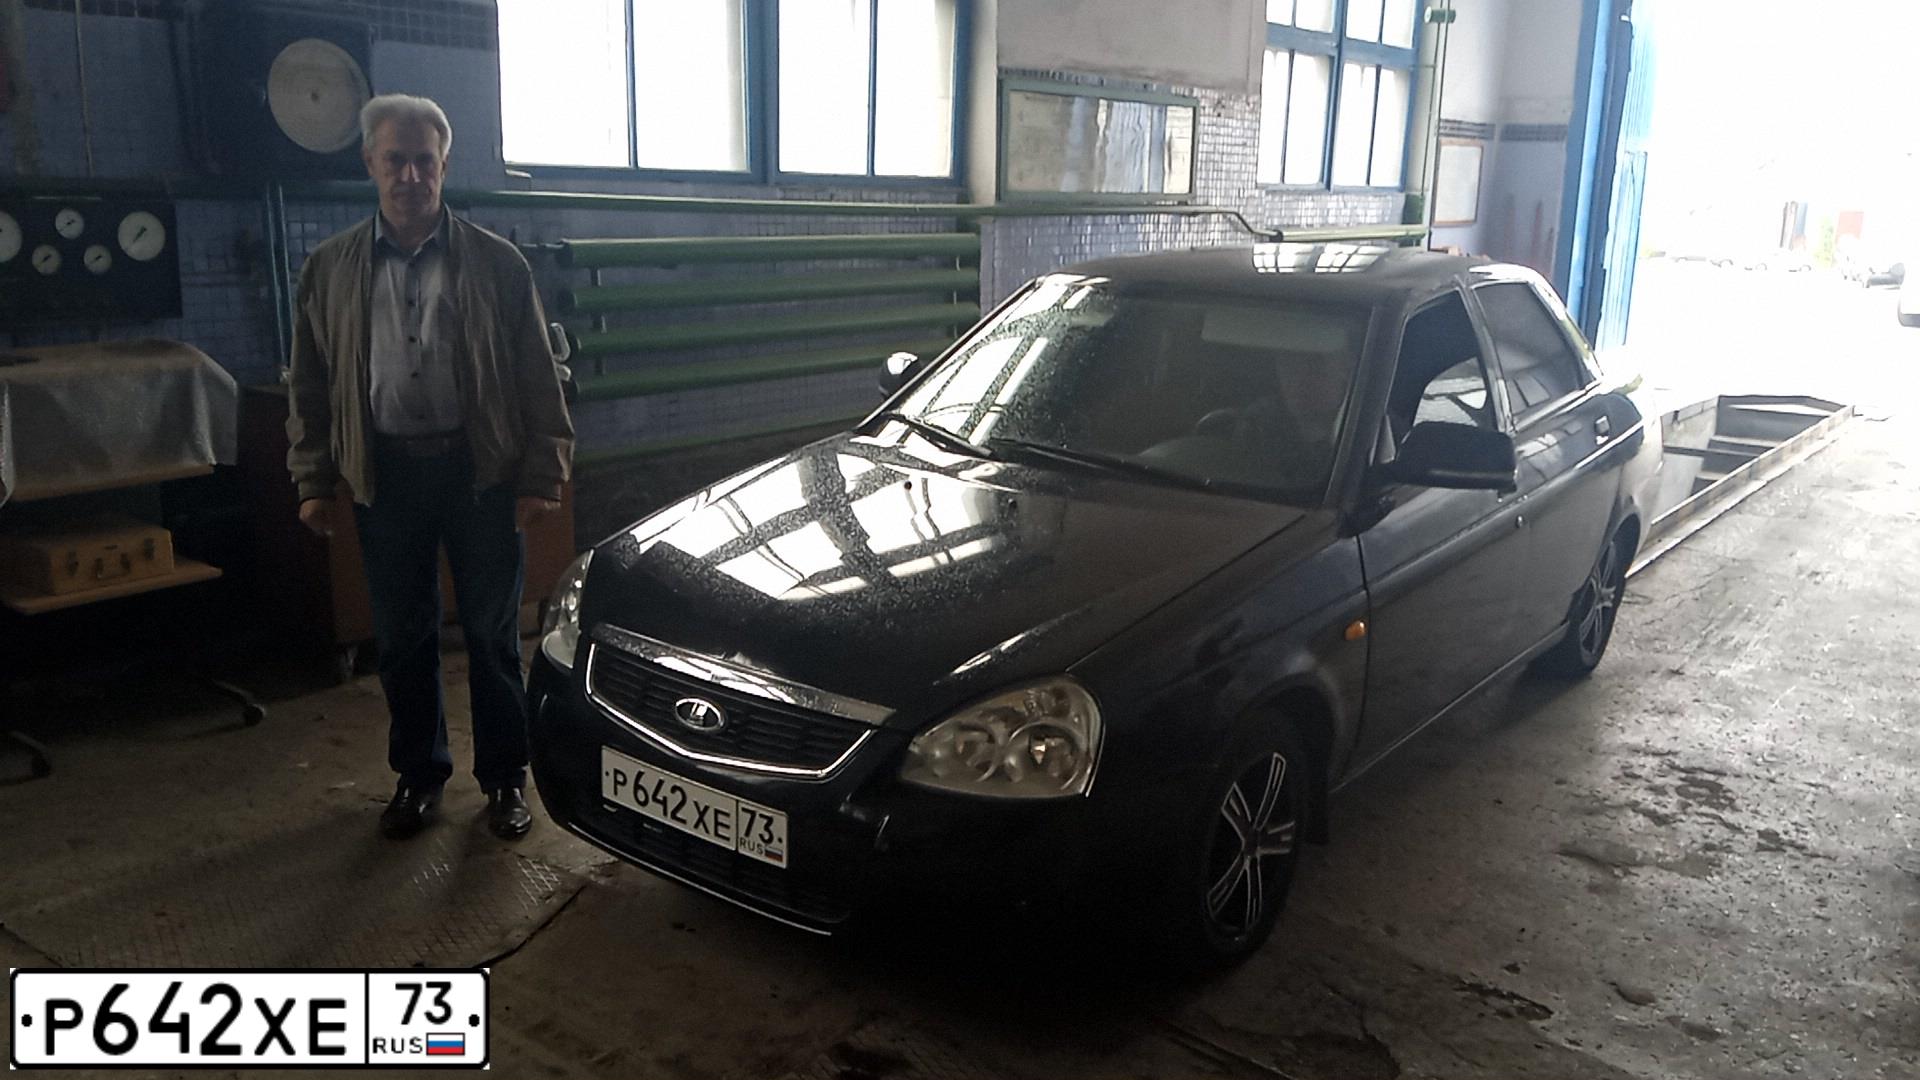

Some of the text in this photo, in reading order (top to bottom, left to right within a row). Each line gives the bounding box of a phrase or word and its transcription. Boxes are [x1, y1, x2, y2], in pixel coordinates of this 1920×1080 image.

[613, 768, 775, 846] P642XE 73
[739, 837, 764, 856] RUS
